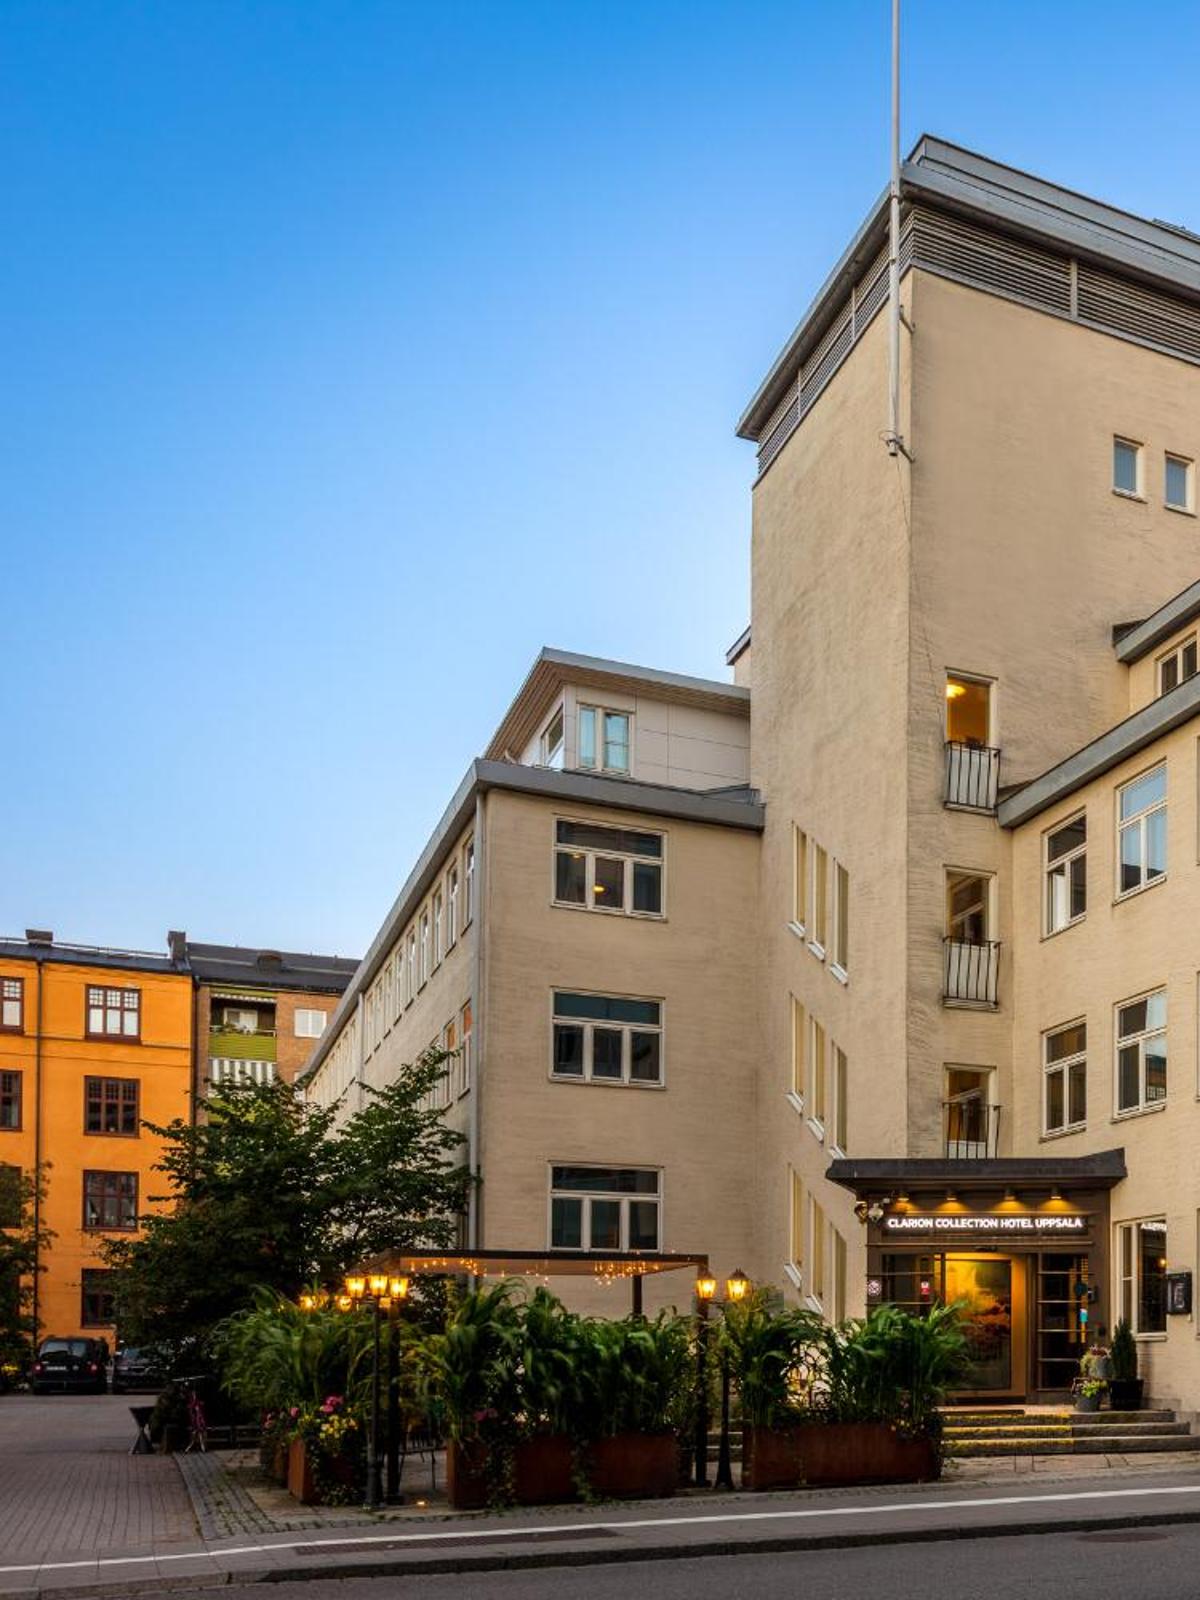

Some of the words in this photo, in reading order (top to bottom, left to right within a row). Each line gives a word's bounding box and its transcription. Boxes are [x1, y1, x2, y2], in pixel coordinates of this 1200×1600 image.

[888, 1218, 933, 1228] CLARION
[935, 1218, 998, 1228] COLLECTION
[1000, 1218, 1033, 1228] HOTEL
[1035, 1218, 1082, 1228] UPPSALA
